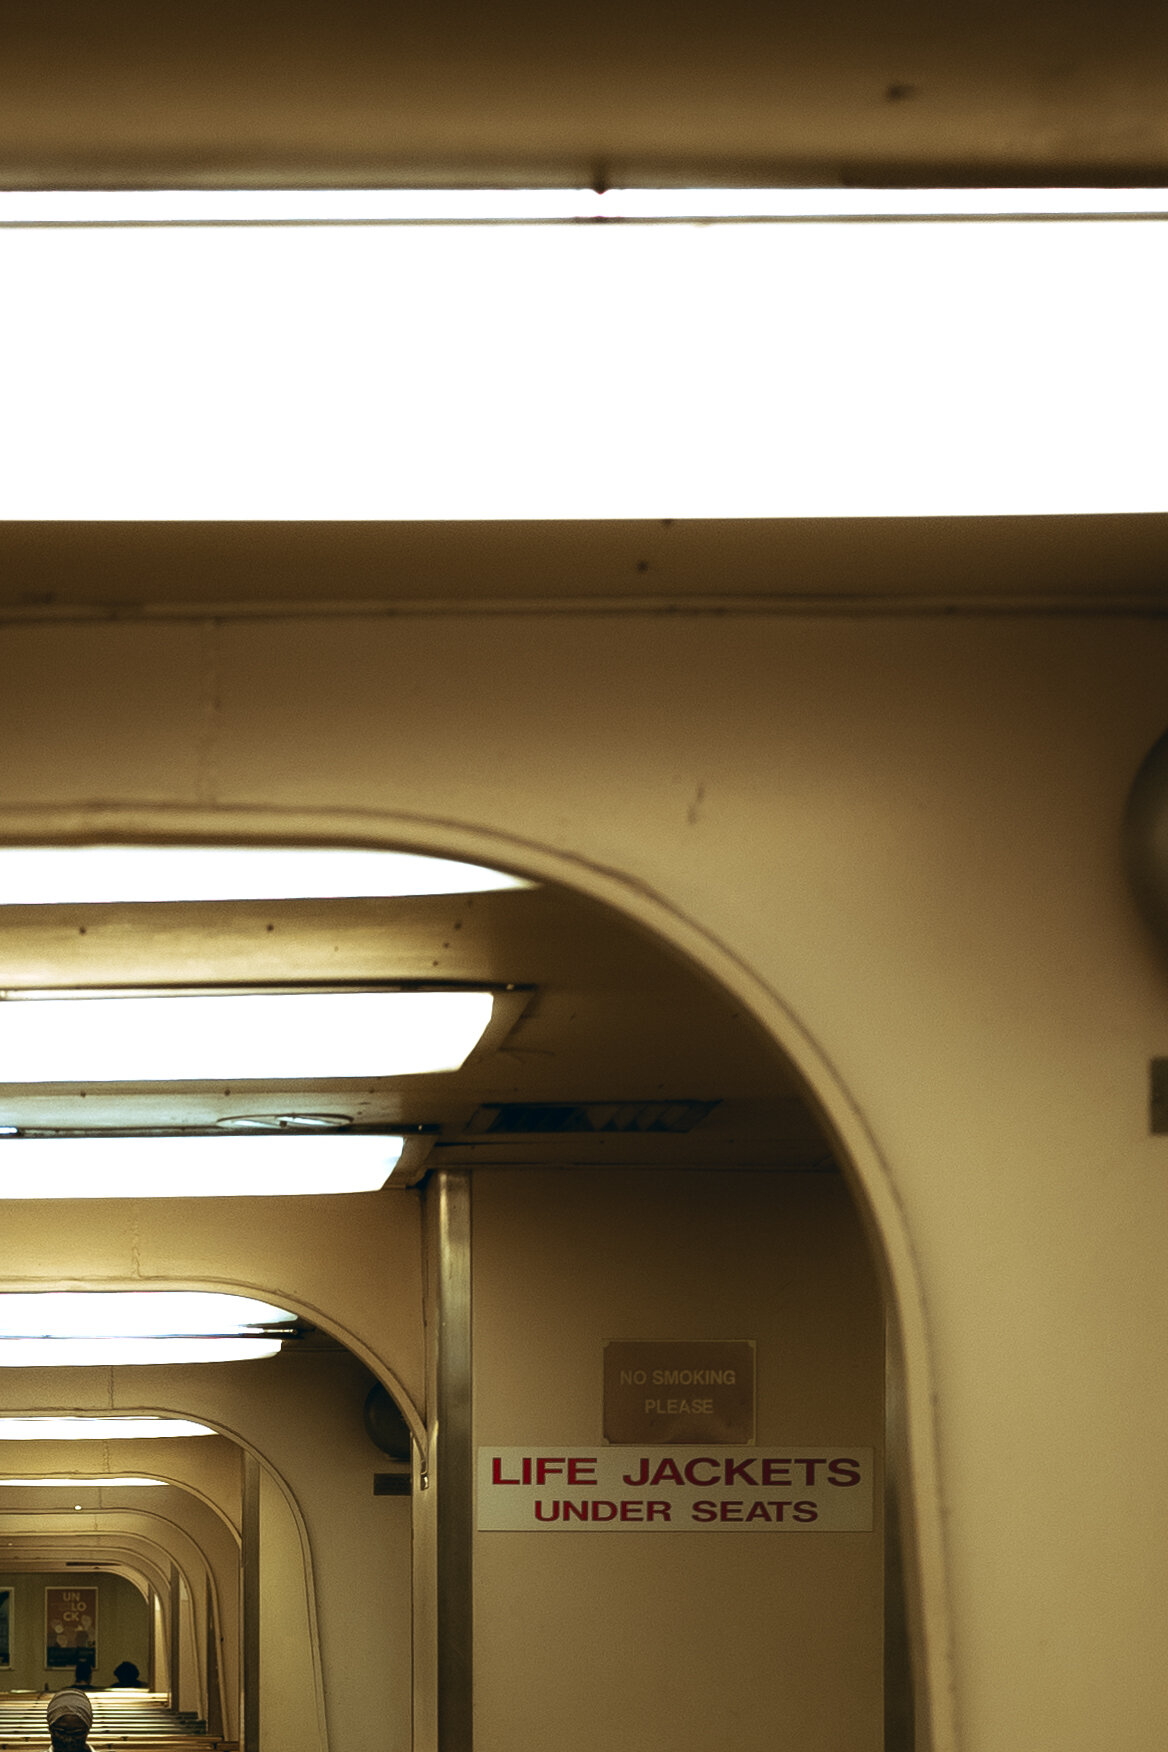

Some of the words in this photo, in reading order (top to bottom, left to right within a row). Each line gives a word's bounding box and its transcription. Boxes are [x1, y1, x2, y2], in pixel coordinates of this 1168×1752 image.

[619, 1369, 647, 1386] NO
[651, 1369, 737, 1386] SMOKING
[644, 1398, 714, 1415] PLEASE
[491, 1457, 598, 1486] LIFE
[622, 1457, 861, 1487] JACKETS
[534, 1500, 671, 1522] UNDER
[691, 1500, 819, 1522] SEATS
[63, 1592, 81, 1602] UN
